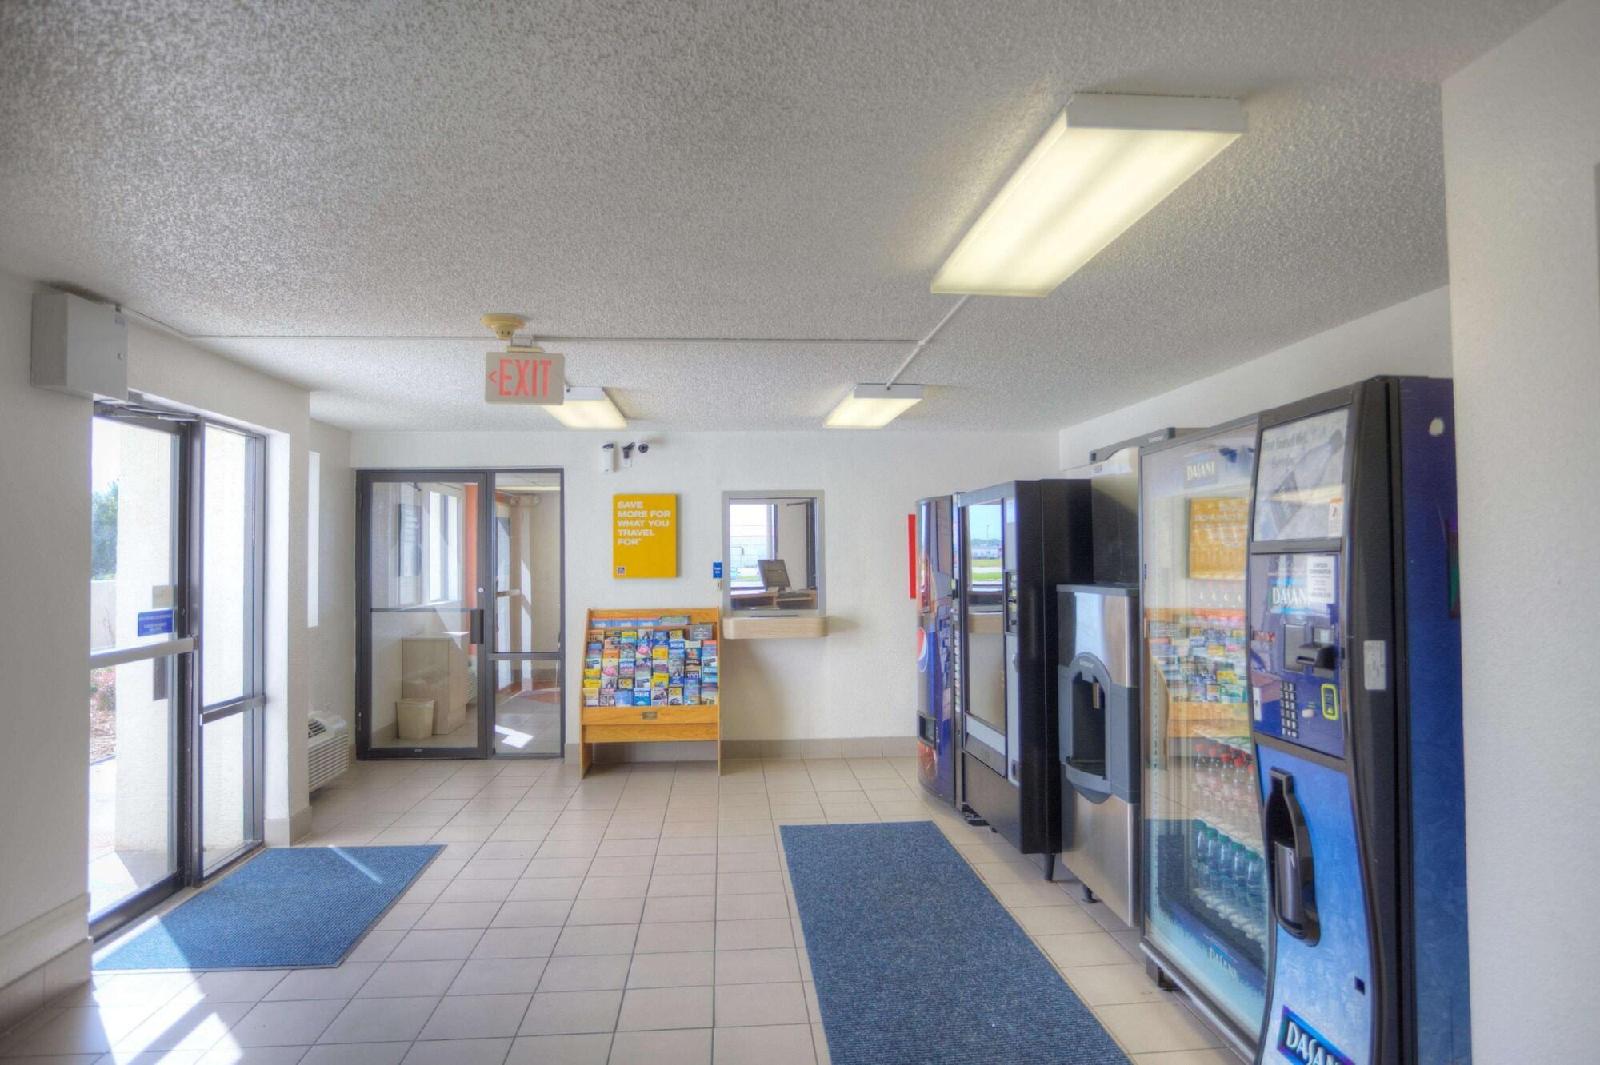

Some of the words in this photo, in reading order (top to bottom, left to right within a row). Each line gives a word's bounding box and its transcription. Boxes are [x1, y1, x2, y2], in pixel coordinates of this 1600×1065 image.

[499, 358, 552, 399] EXIT
[617, 500, 644, 509] SAVE
[617, 510, 648, 518] MORE
[649, 510, 671, 518] FOR
[617, 519, 645, 527] WHAT
[648, 519, 670, 527] YOU
[617, 528, 655, 537] TRAVEL
